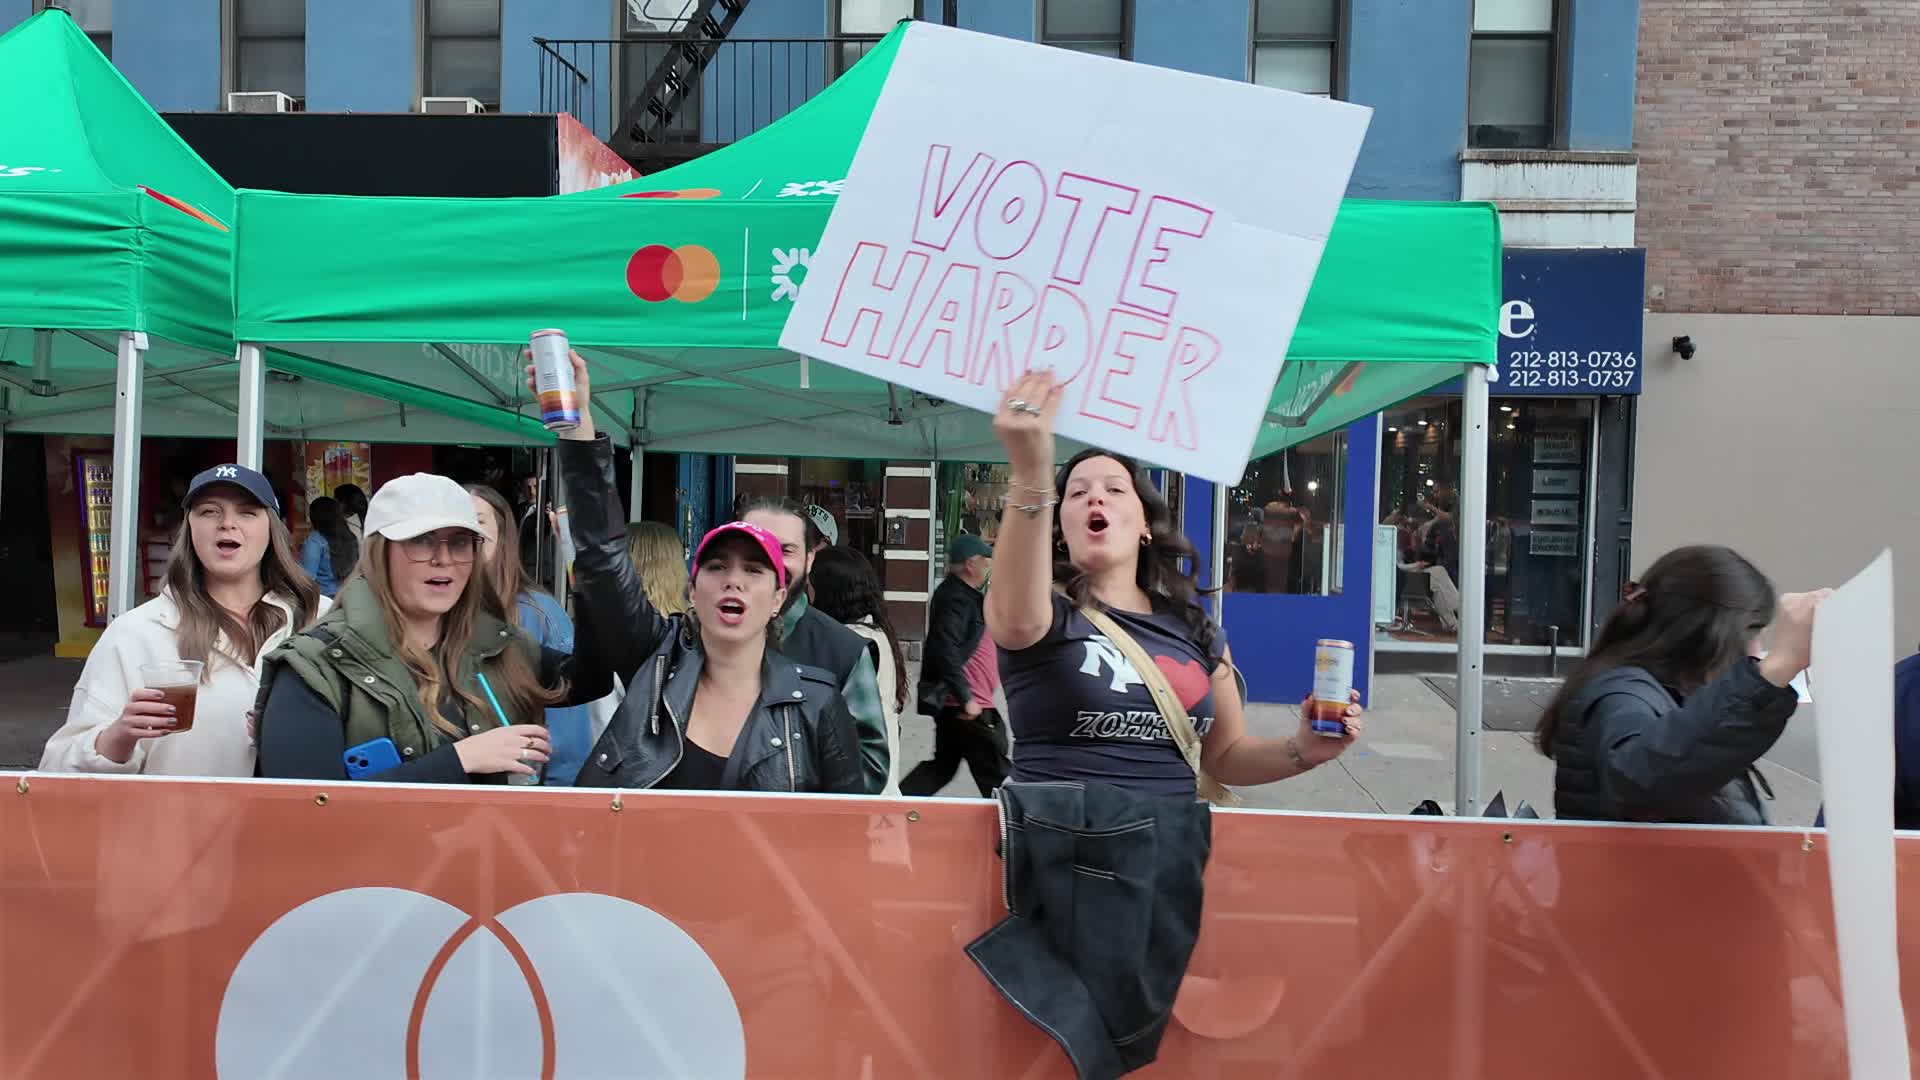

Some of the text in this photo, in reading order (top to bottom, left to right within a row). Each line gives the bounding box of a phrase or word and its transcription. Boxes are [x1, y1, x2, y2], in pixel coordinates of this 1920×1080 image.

[911, 144, 1214, 317] VOTE
[821, 241, 1222, 450] HARDER
[1509, 370, 1635, 387] 212-813-0737
[1510, 352, 1637, 368] 212-813-0736
